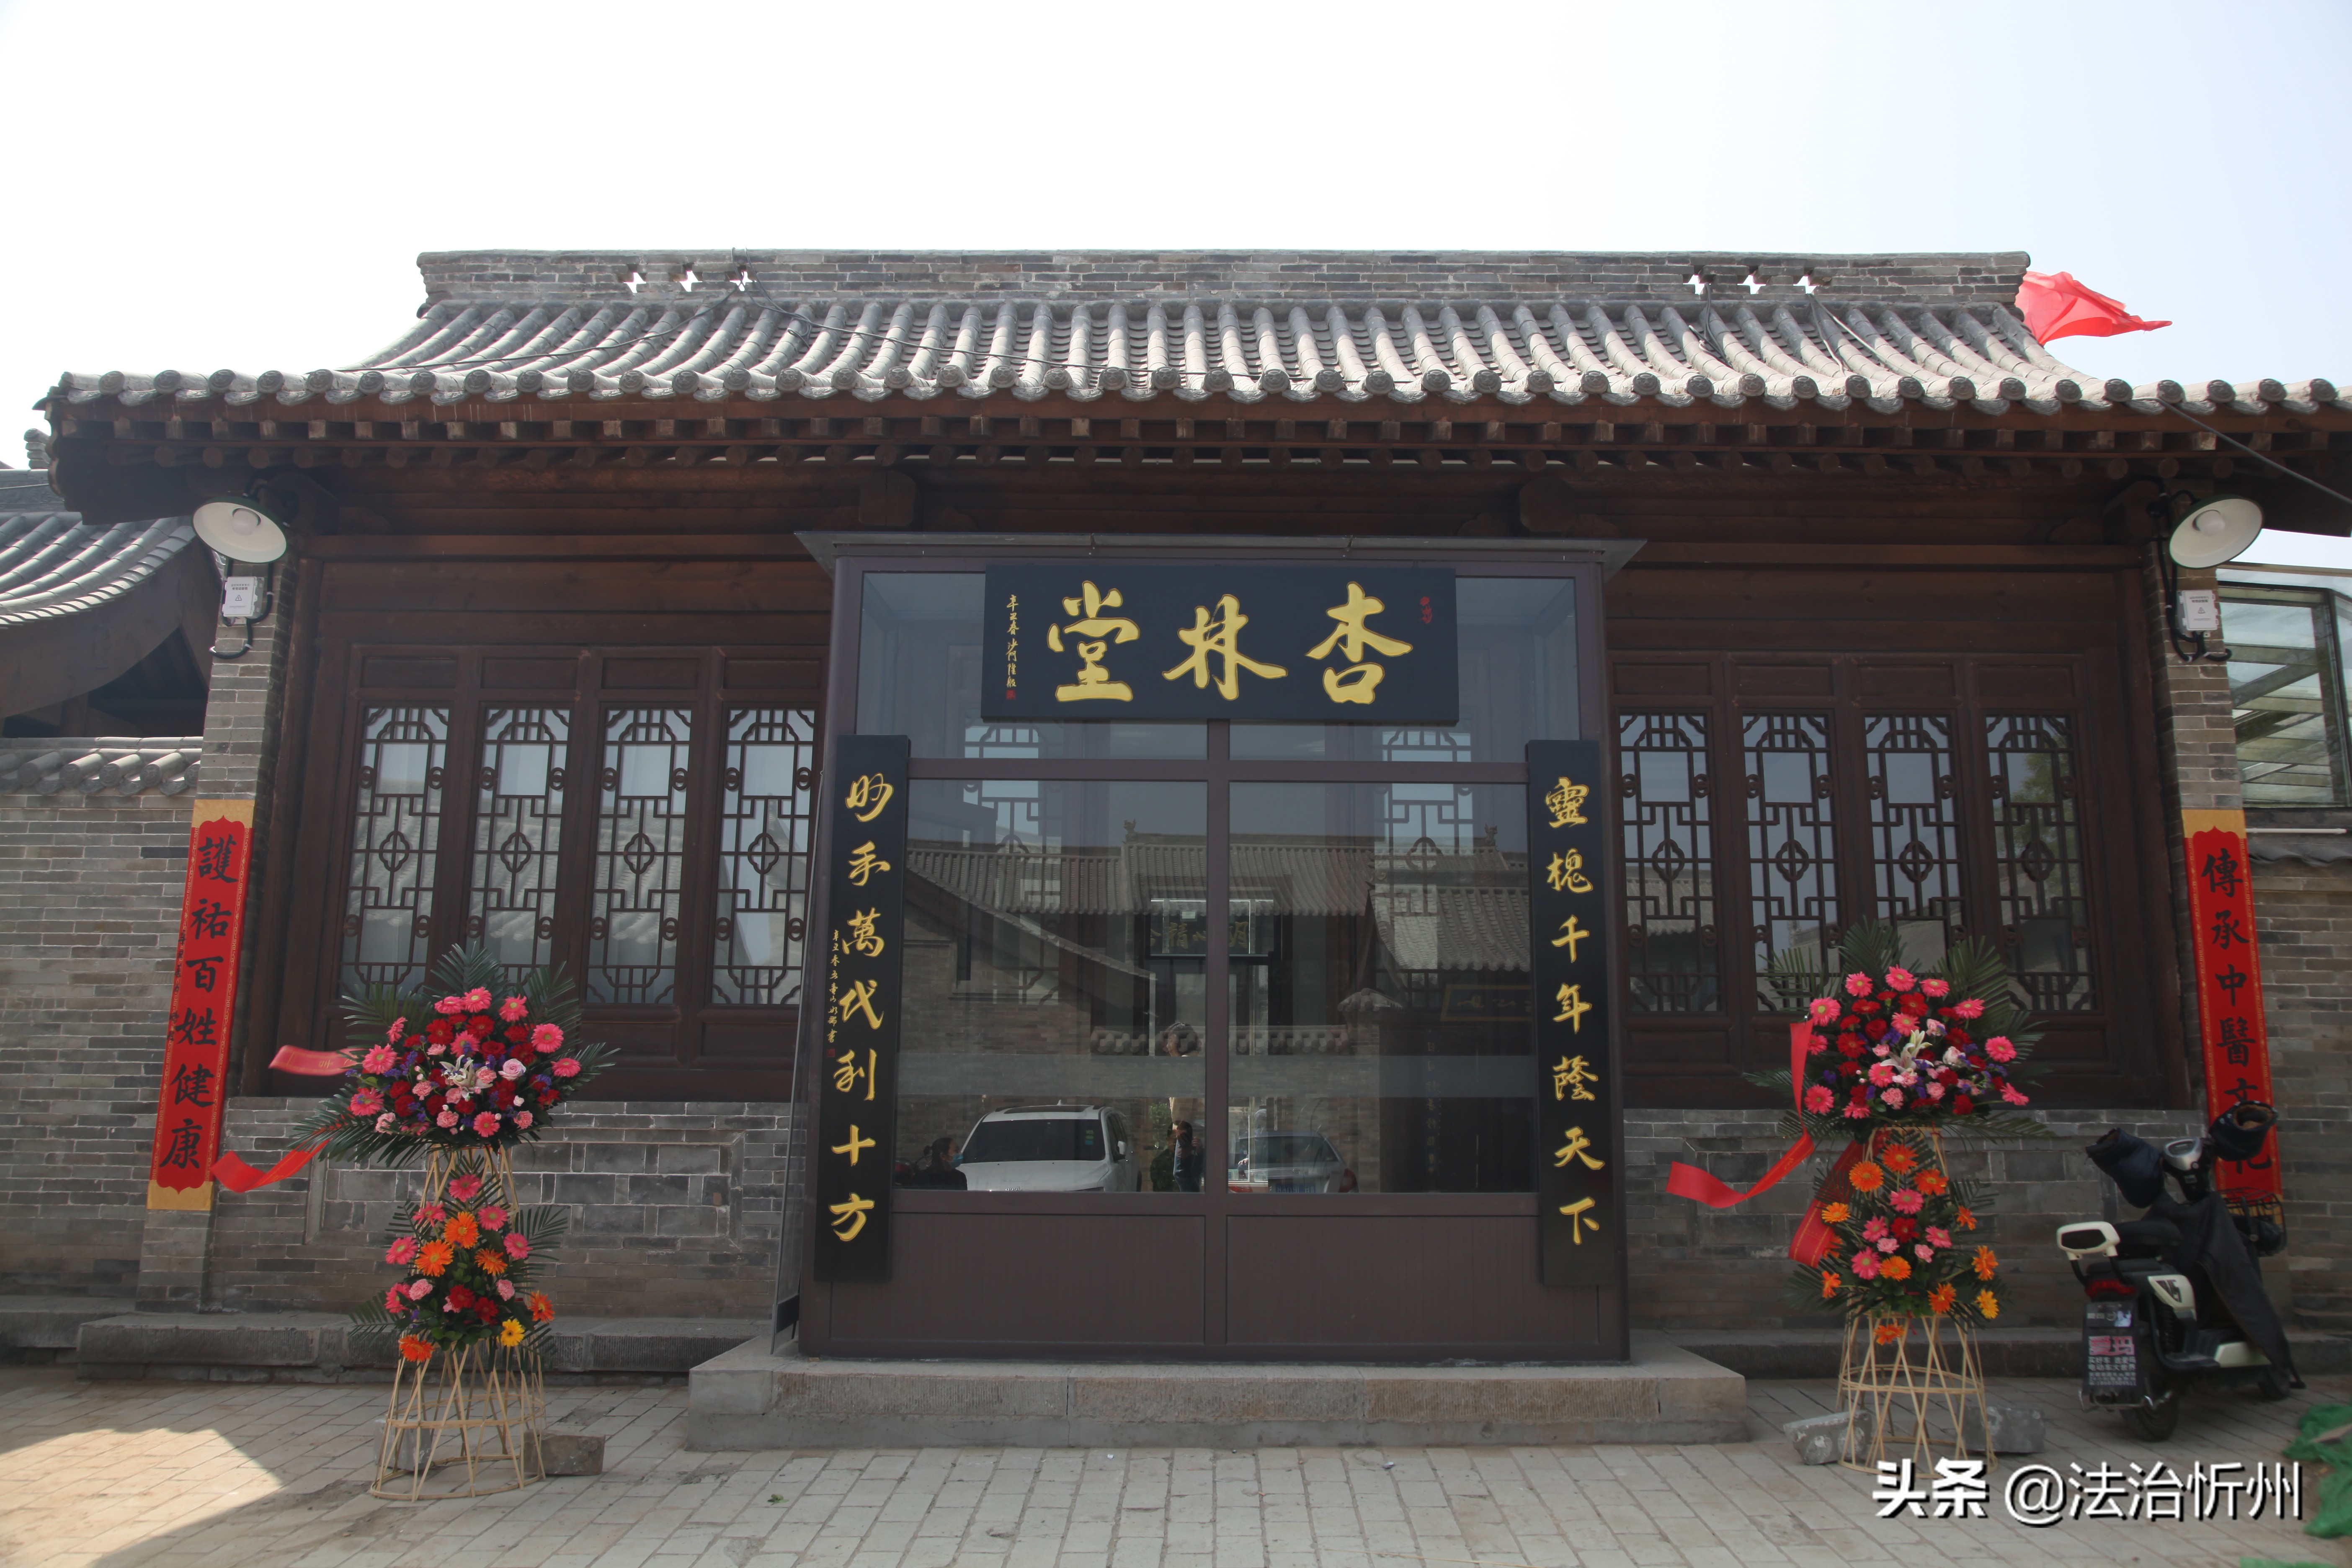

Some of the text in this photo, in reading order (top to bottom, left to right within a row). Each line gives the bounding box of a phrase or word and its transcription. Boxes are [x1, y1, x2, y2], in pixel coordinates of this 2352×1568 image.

[1047, 581, 1413, 704] 杏林堂
[160, 834, 238, 1169] 護祐百姓健康
